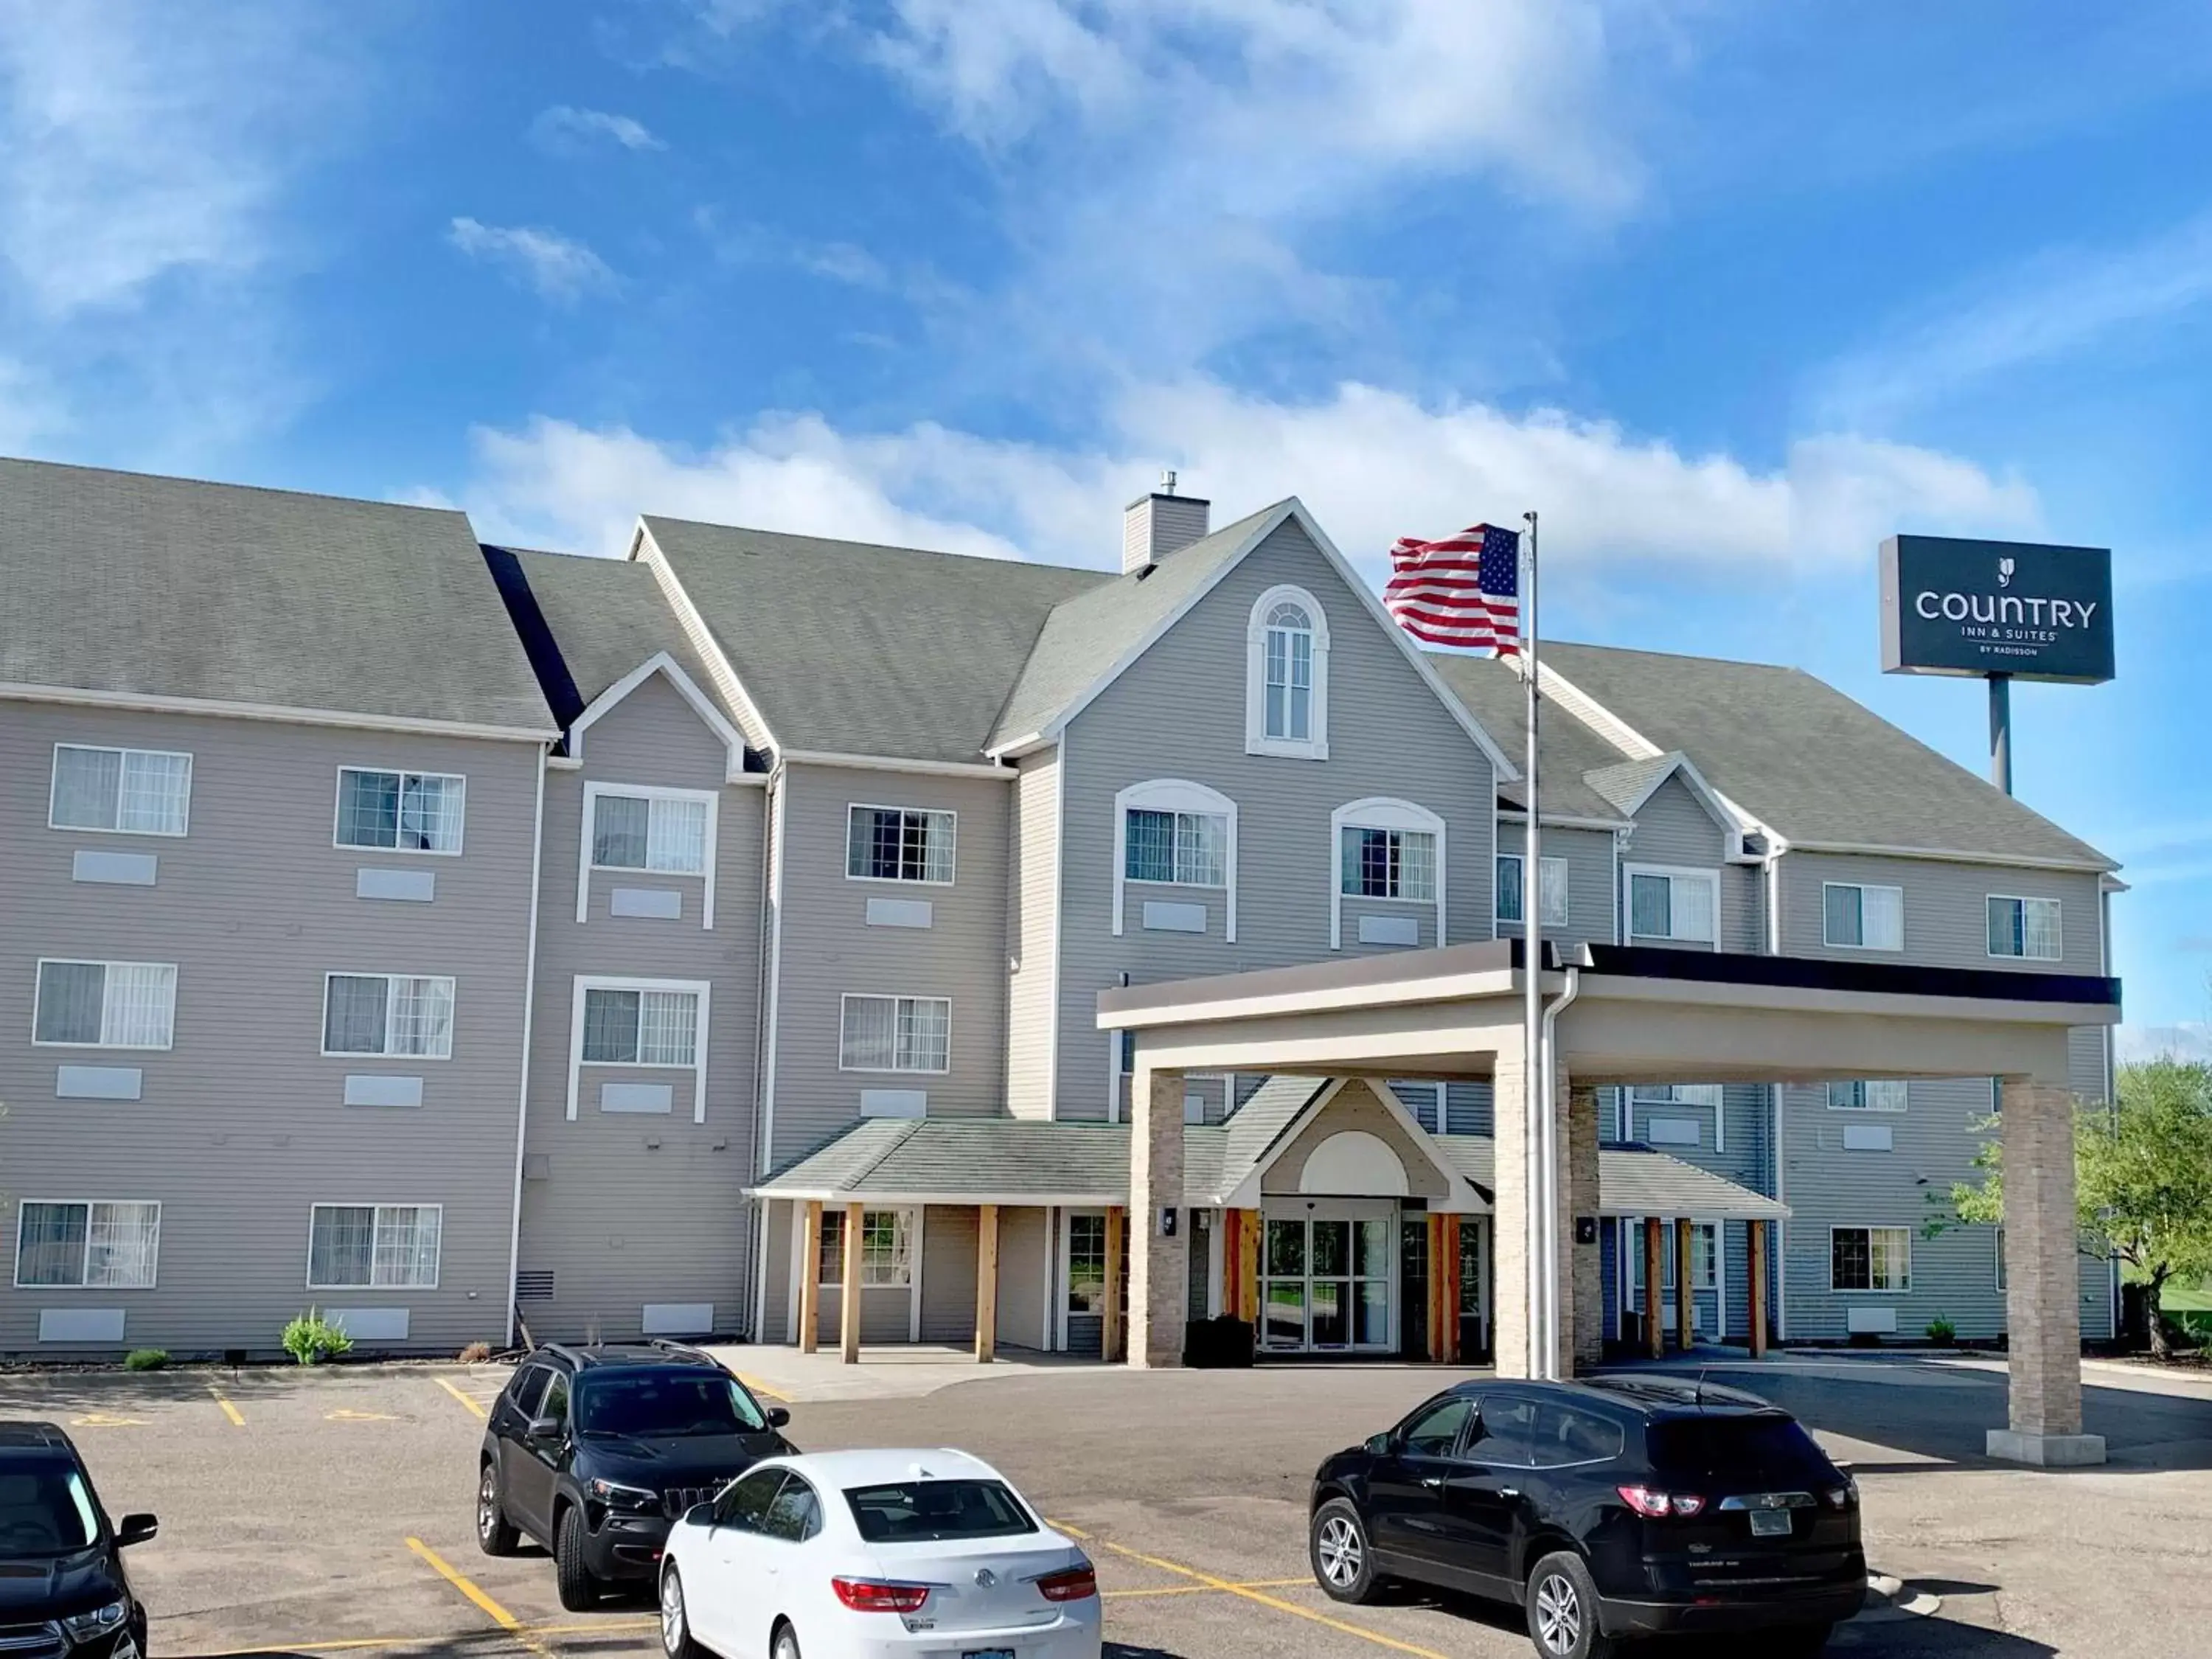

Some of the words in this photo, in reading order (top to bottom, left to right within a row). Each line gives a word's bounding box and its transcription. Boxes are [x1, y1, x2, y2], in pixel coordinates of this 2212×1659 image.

[1961, 626, 1986, 637] INN
[1992, 627, 2000, 639] &
[2006, 629, 2056, 641] SUITES
[1980, 645, 1991, 653] BY
[1994, 646, 2037, 656] RADISSON
